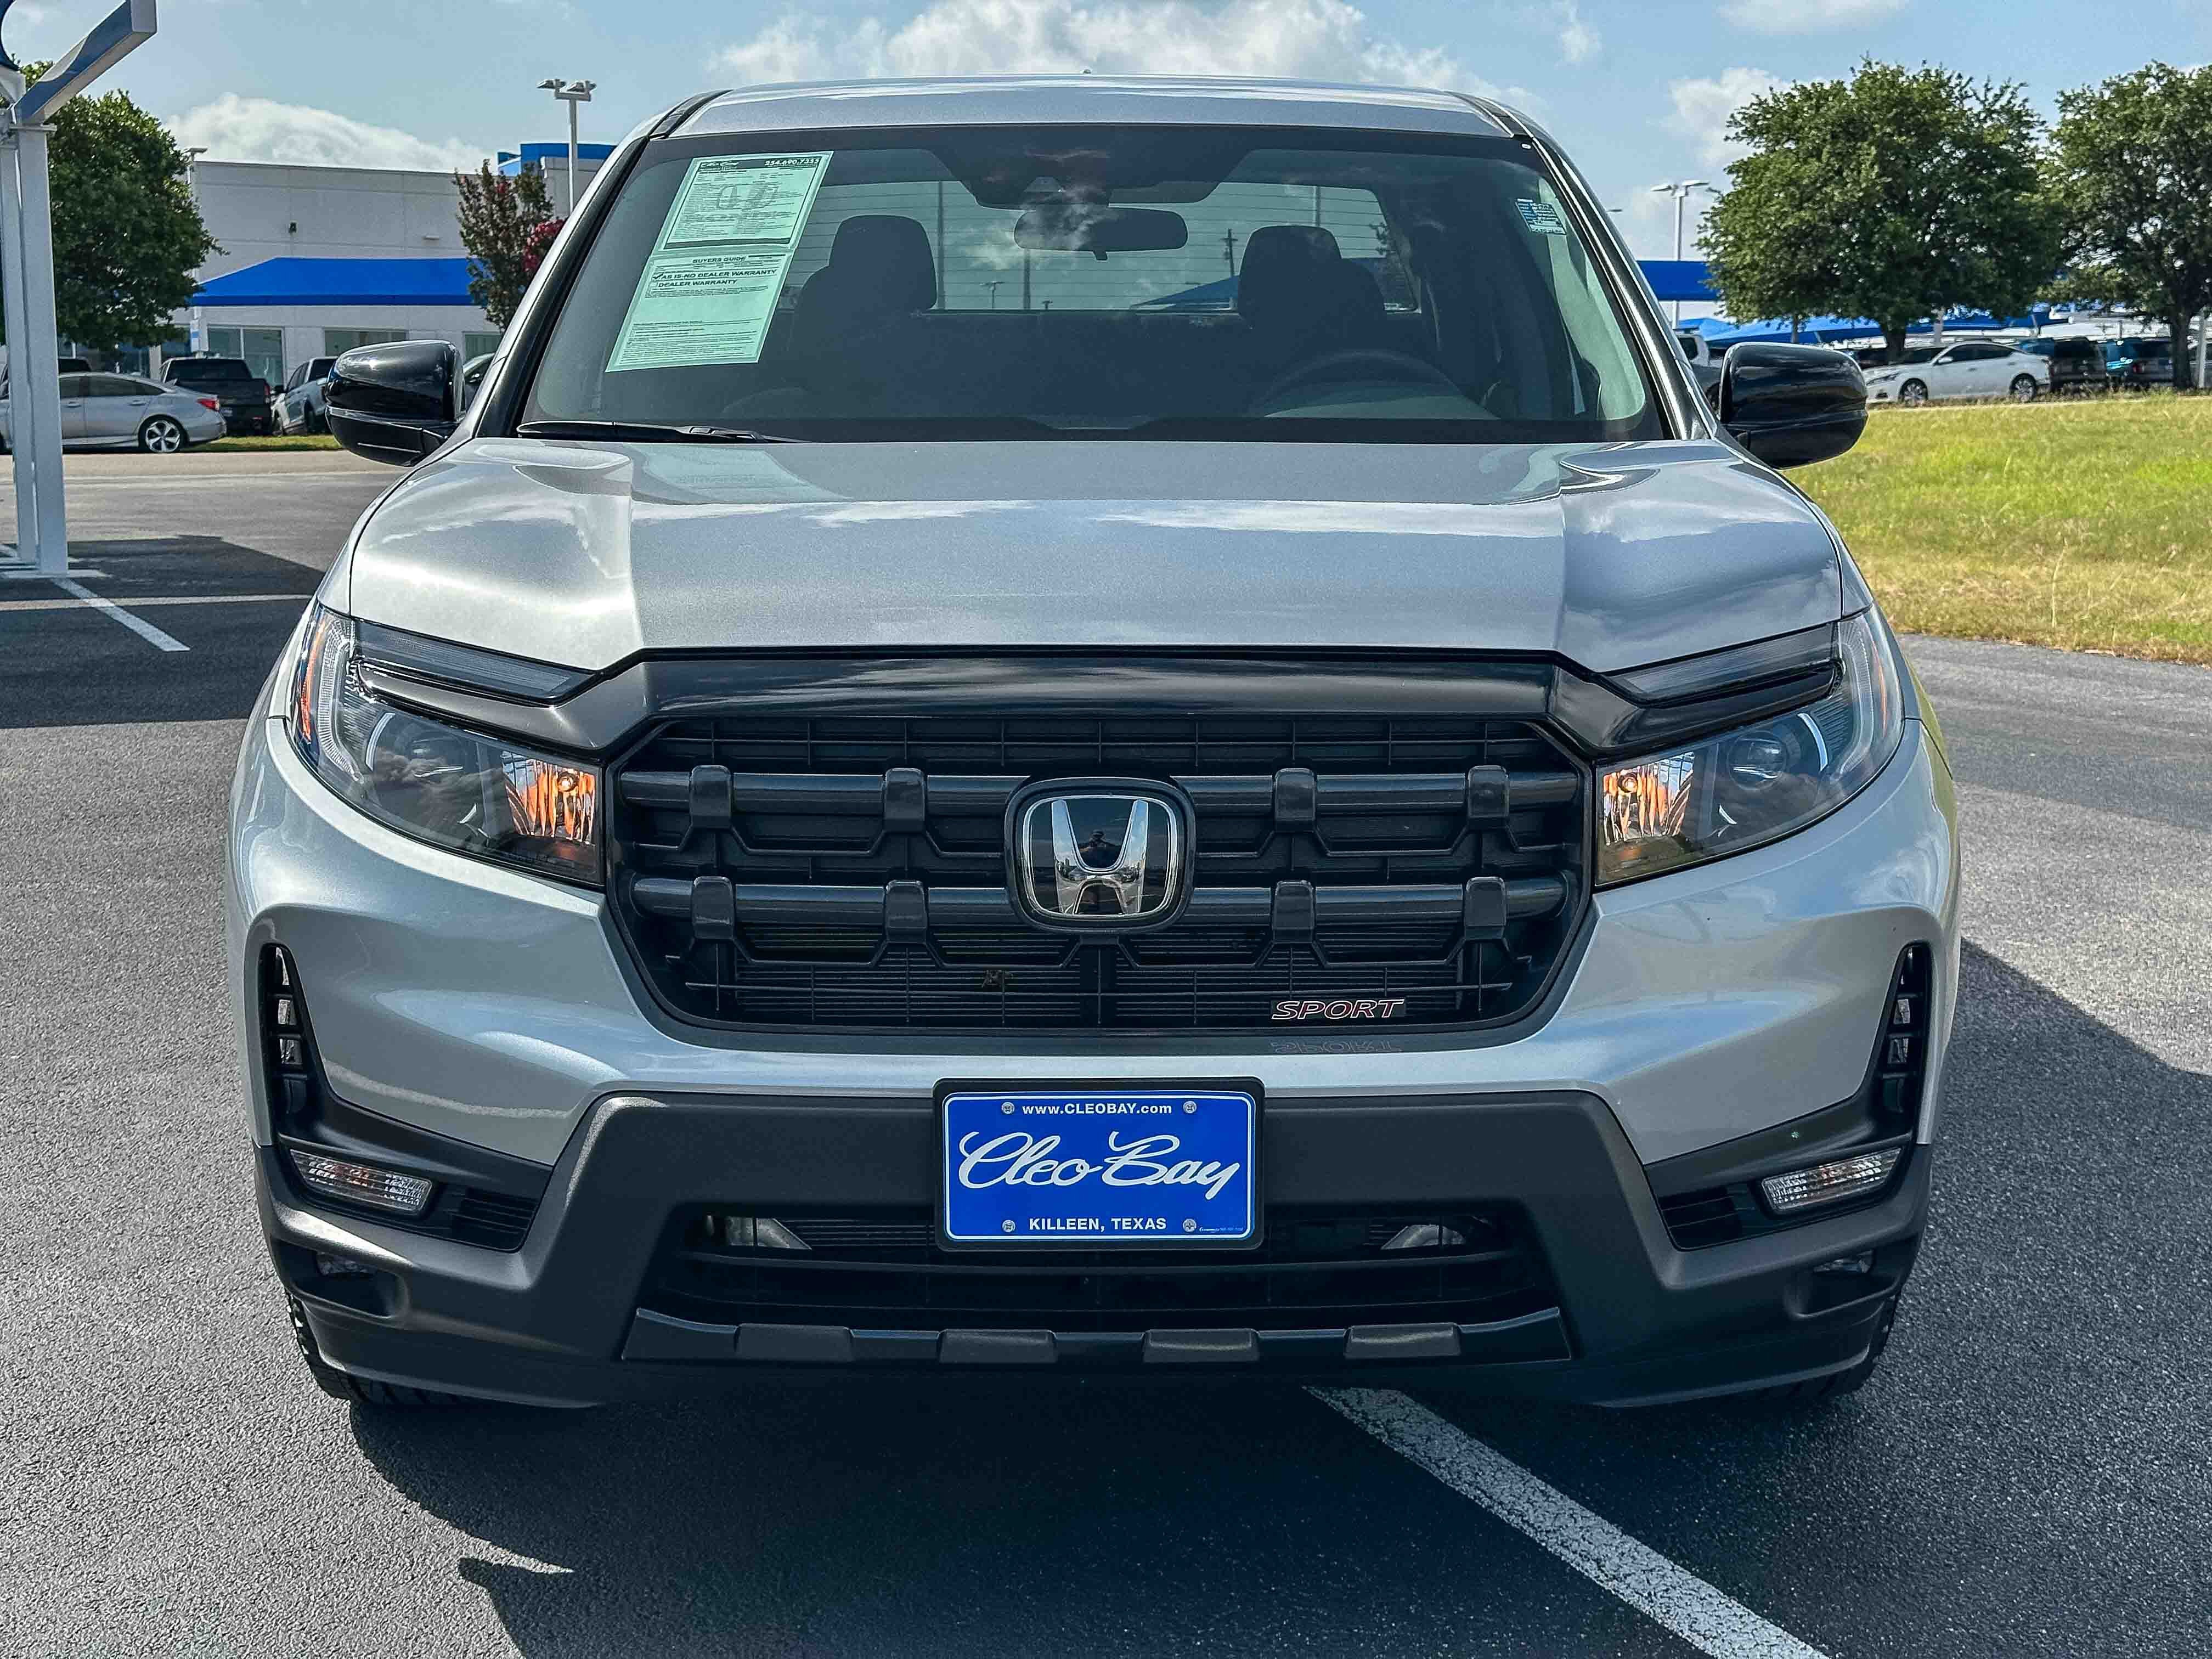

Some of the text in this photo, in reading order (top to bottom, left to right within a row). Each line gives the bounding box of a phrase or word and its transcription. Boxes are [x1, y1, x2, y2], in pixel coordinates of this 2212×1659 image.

[1272, 998, 1405, 1019] SPORT
[1022, 1103, 1172, 1115] www.CLEOBAY.com
[958, 1131, 1240, 1200] Cleo Bay
[1029, 1217, 1167, 1233] KILLEEN, TEXAS
